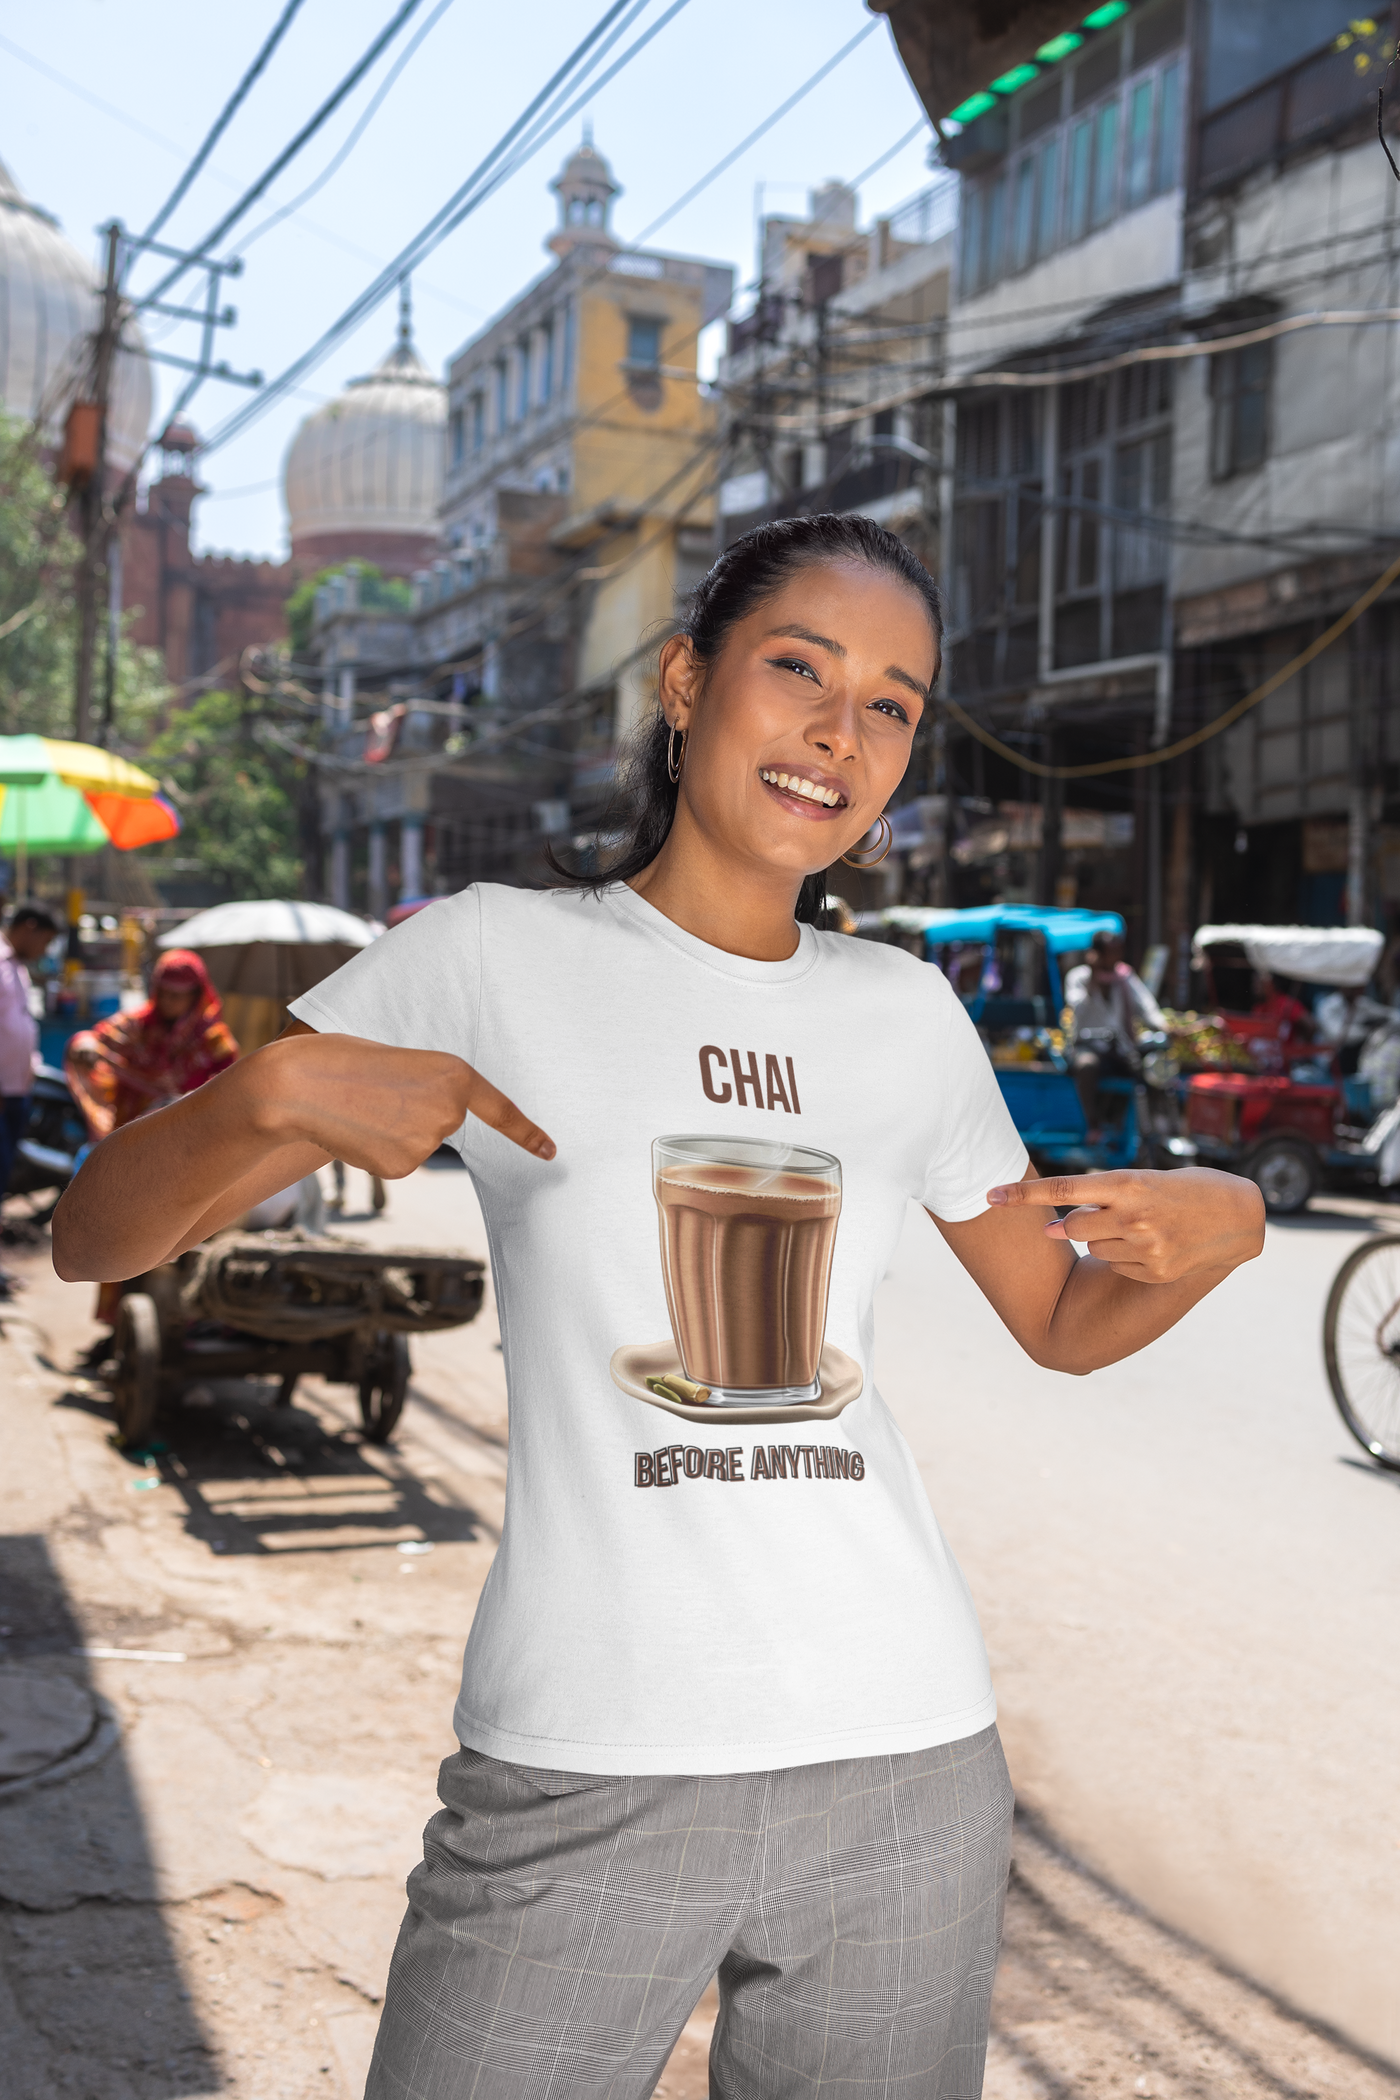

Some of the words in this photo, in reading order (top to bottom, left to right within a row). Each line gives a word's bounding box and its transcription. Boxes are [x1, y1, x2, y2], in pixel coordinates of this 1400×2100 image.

[698, 1044, 802, 1115] CHAI
[634, 1444, 745, 1488] BEFORE
[750, 1445, 866, 1482] ANYTHING
